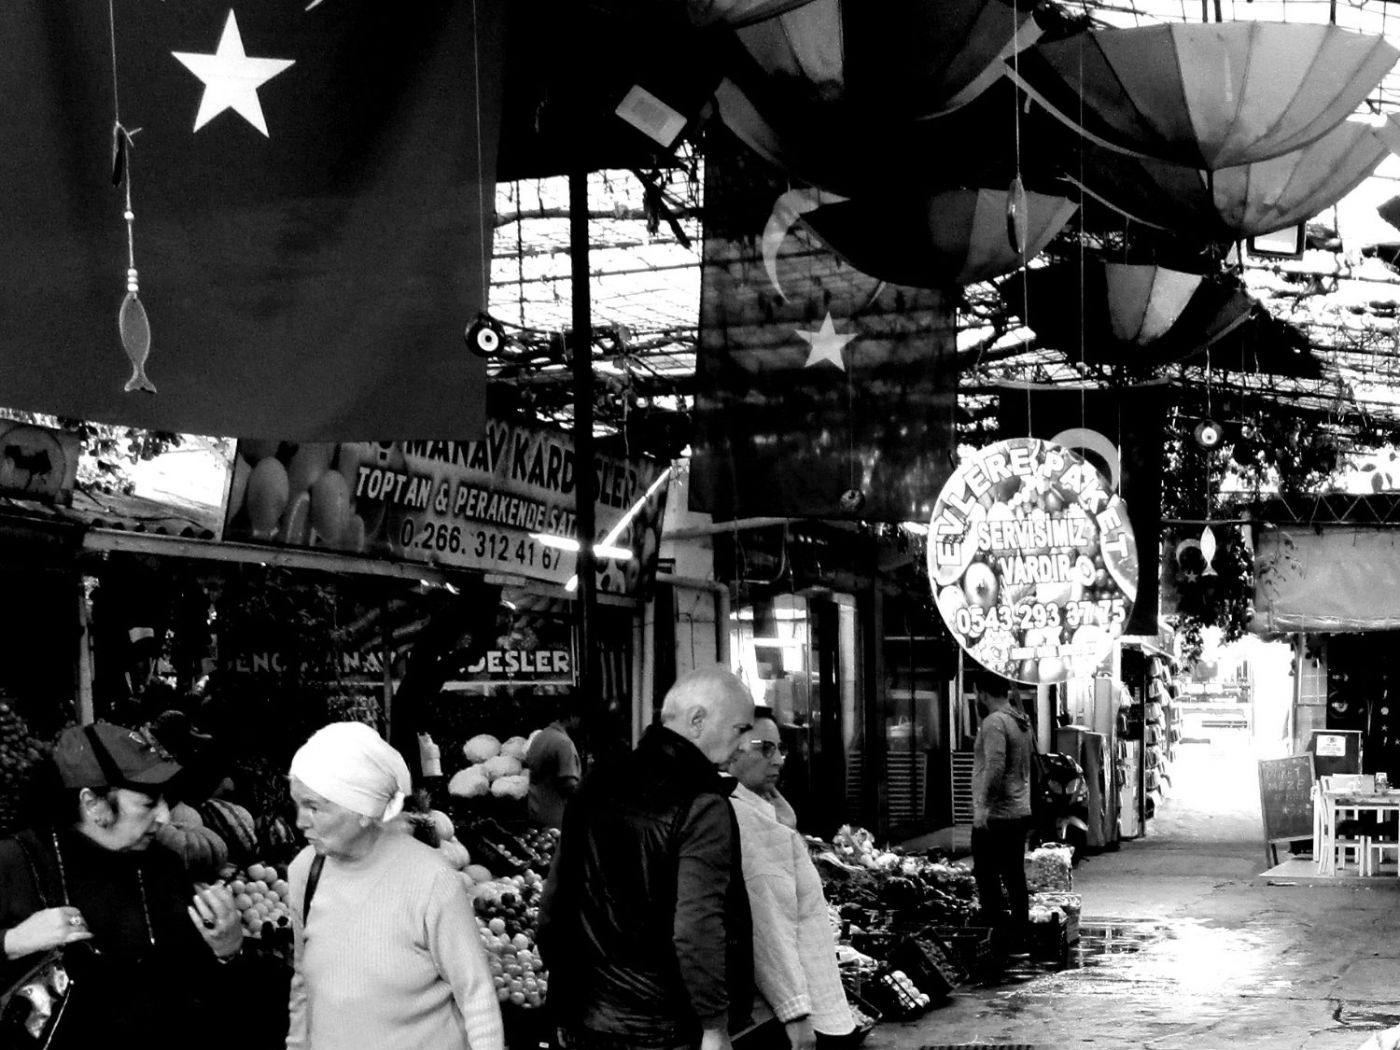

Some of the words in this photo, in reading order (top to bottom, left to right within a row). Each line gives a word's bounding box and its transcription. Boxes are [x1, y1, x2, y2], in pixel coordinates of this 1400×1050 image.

[355, 465, 432, 509] TOPTAN
[435, 483, 449, 514] &
[454, 485, 546, 533] PERAKENDE
[474, 529, 509, 562] 312
[515, 540, 536, 567] 41
[541, 547, 561, 572] 67
[956, 605, 1014, 635] 0543
[1018, 602, 1060, 630] 293
